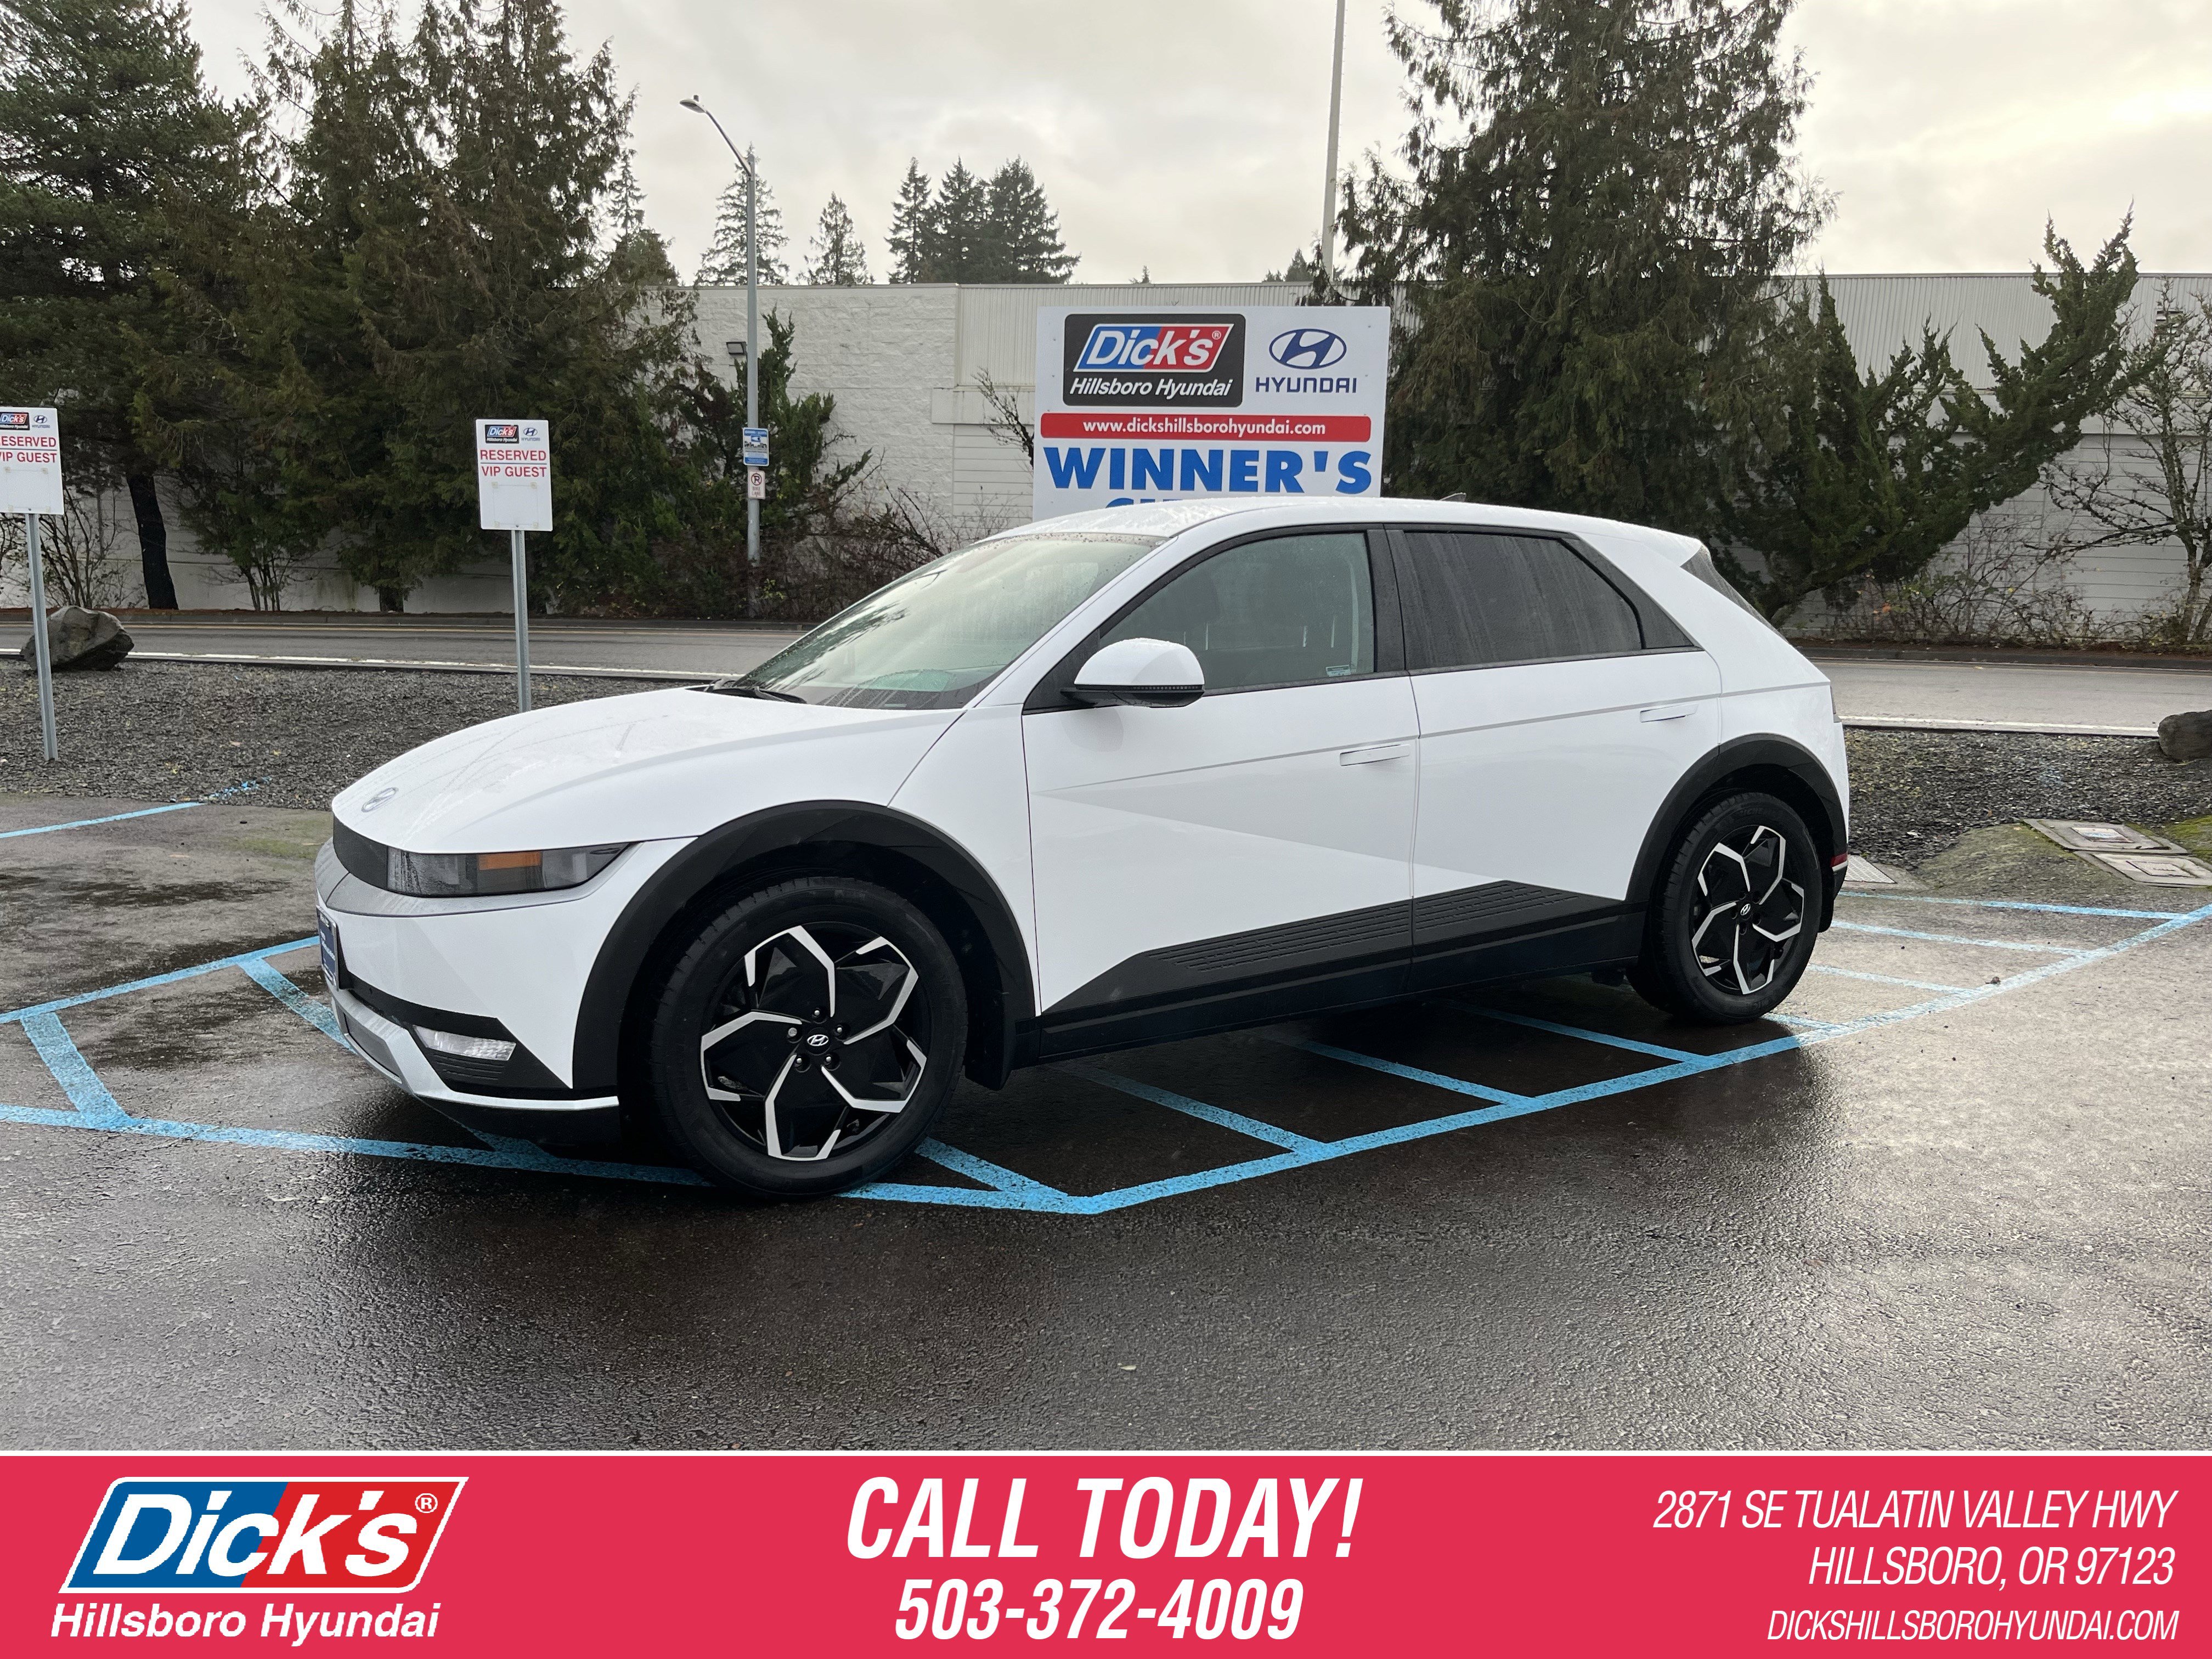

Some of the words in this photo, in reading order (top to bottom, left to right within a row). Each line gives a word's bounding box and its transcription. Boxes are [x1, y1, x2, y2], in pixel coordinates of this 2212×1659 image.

[1086, 330, 1214, 366] Dick's
[1070, 377, 1153, 395] Hillsboro
[1155, 379, 1233, 399] Hyundai
[1256, 377, 1357, 393] HYUNDAI
[489, 427, 514, 436] Dick's
[1083, 416, 1326, 438] www.dickshillsborohyundai.com
[0, 436, 57, 447] ESERVED
[17, 452, 57, 463] GUEST
[480, 449, 546, 461] RESERVED
[482, 466, 500, 477] VIP
[505, 466, 547, 477] GUEST
[1043, 447, 1372, 494] WINNER'S
